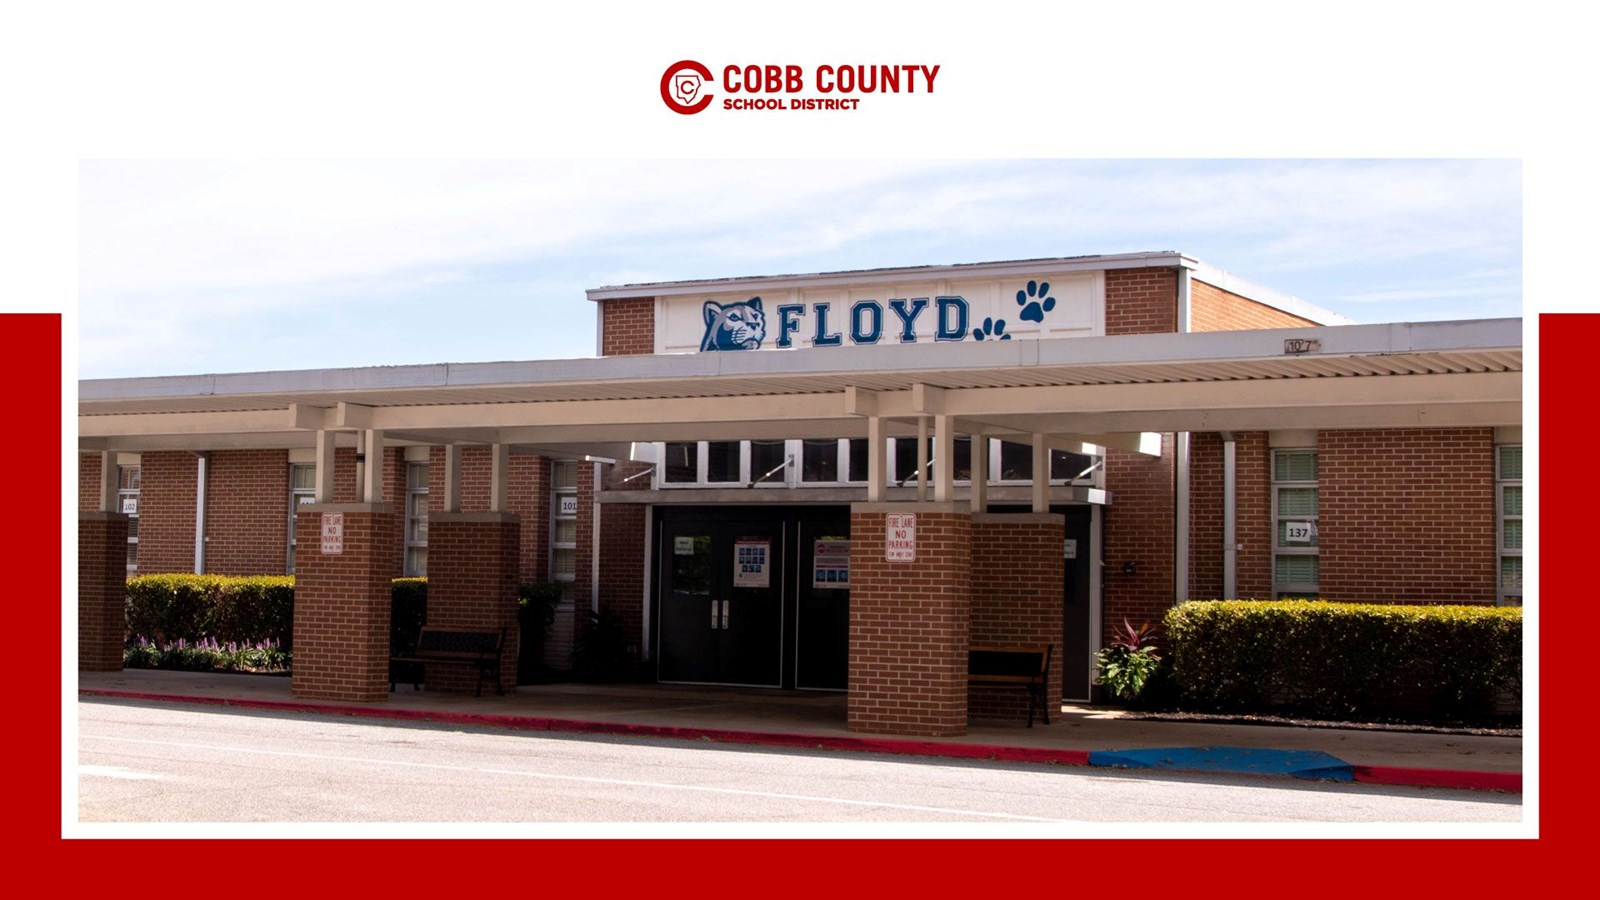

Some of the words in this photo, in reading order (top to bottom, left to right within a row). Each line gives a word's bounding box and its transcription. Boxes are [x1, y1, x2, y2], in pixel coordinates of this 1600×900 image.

[775, 295, 970, 349] FLOYD
[563, 501, 576, 510] 101
[323, 516, 332, 525] FIRE
[333, 516, 342, 525] LANE
[889, 517, 899, 528] FIRE
[901, 517, 913, 528] LANE
[328, 526, 336, 535] NO
[895, 530, 906, 539] NO
[1289, 528, 1308, 538] 137
[322, 535, 342, 543] PARKING
[888, 540, 913, 549] PARKING
